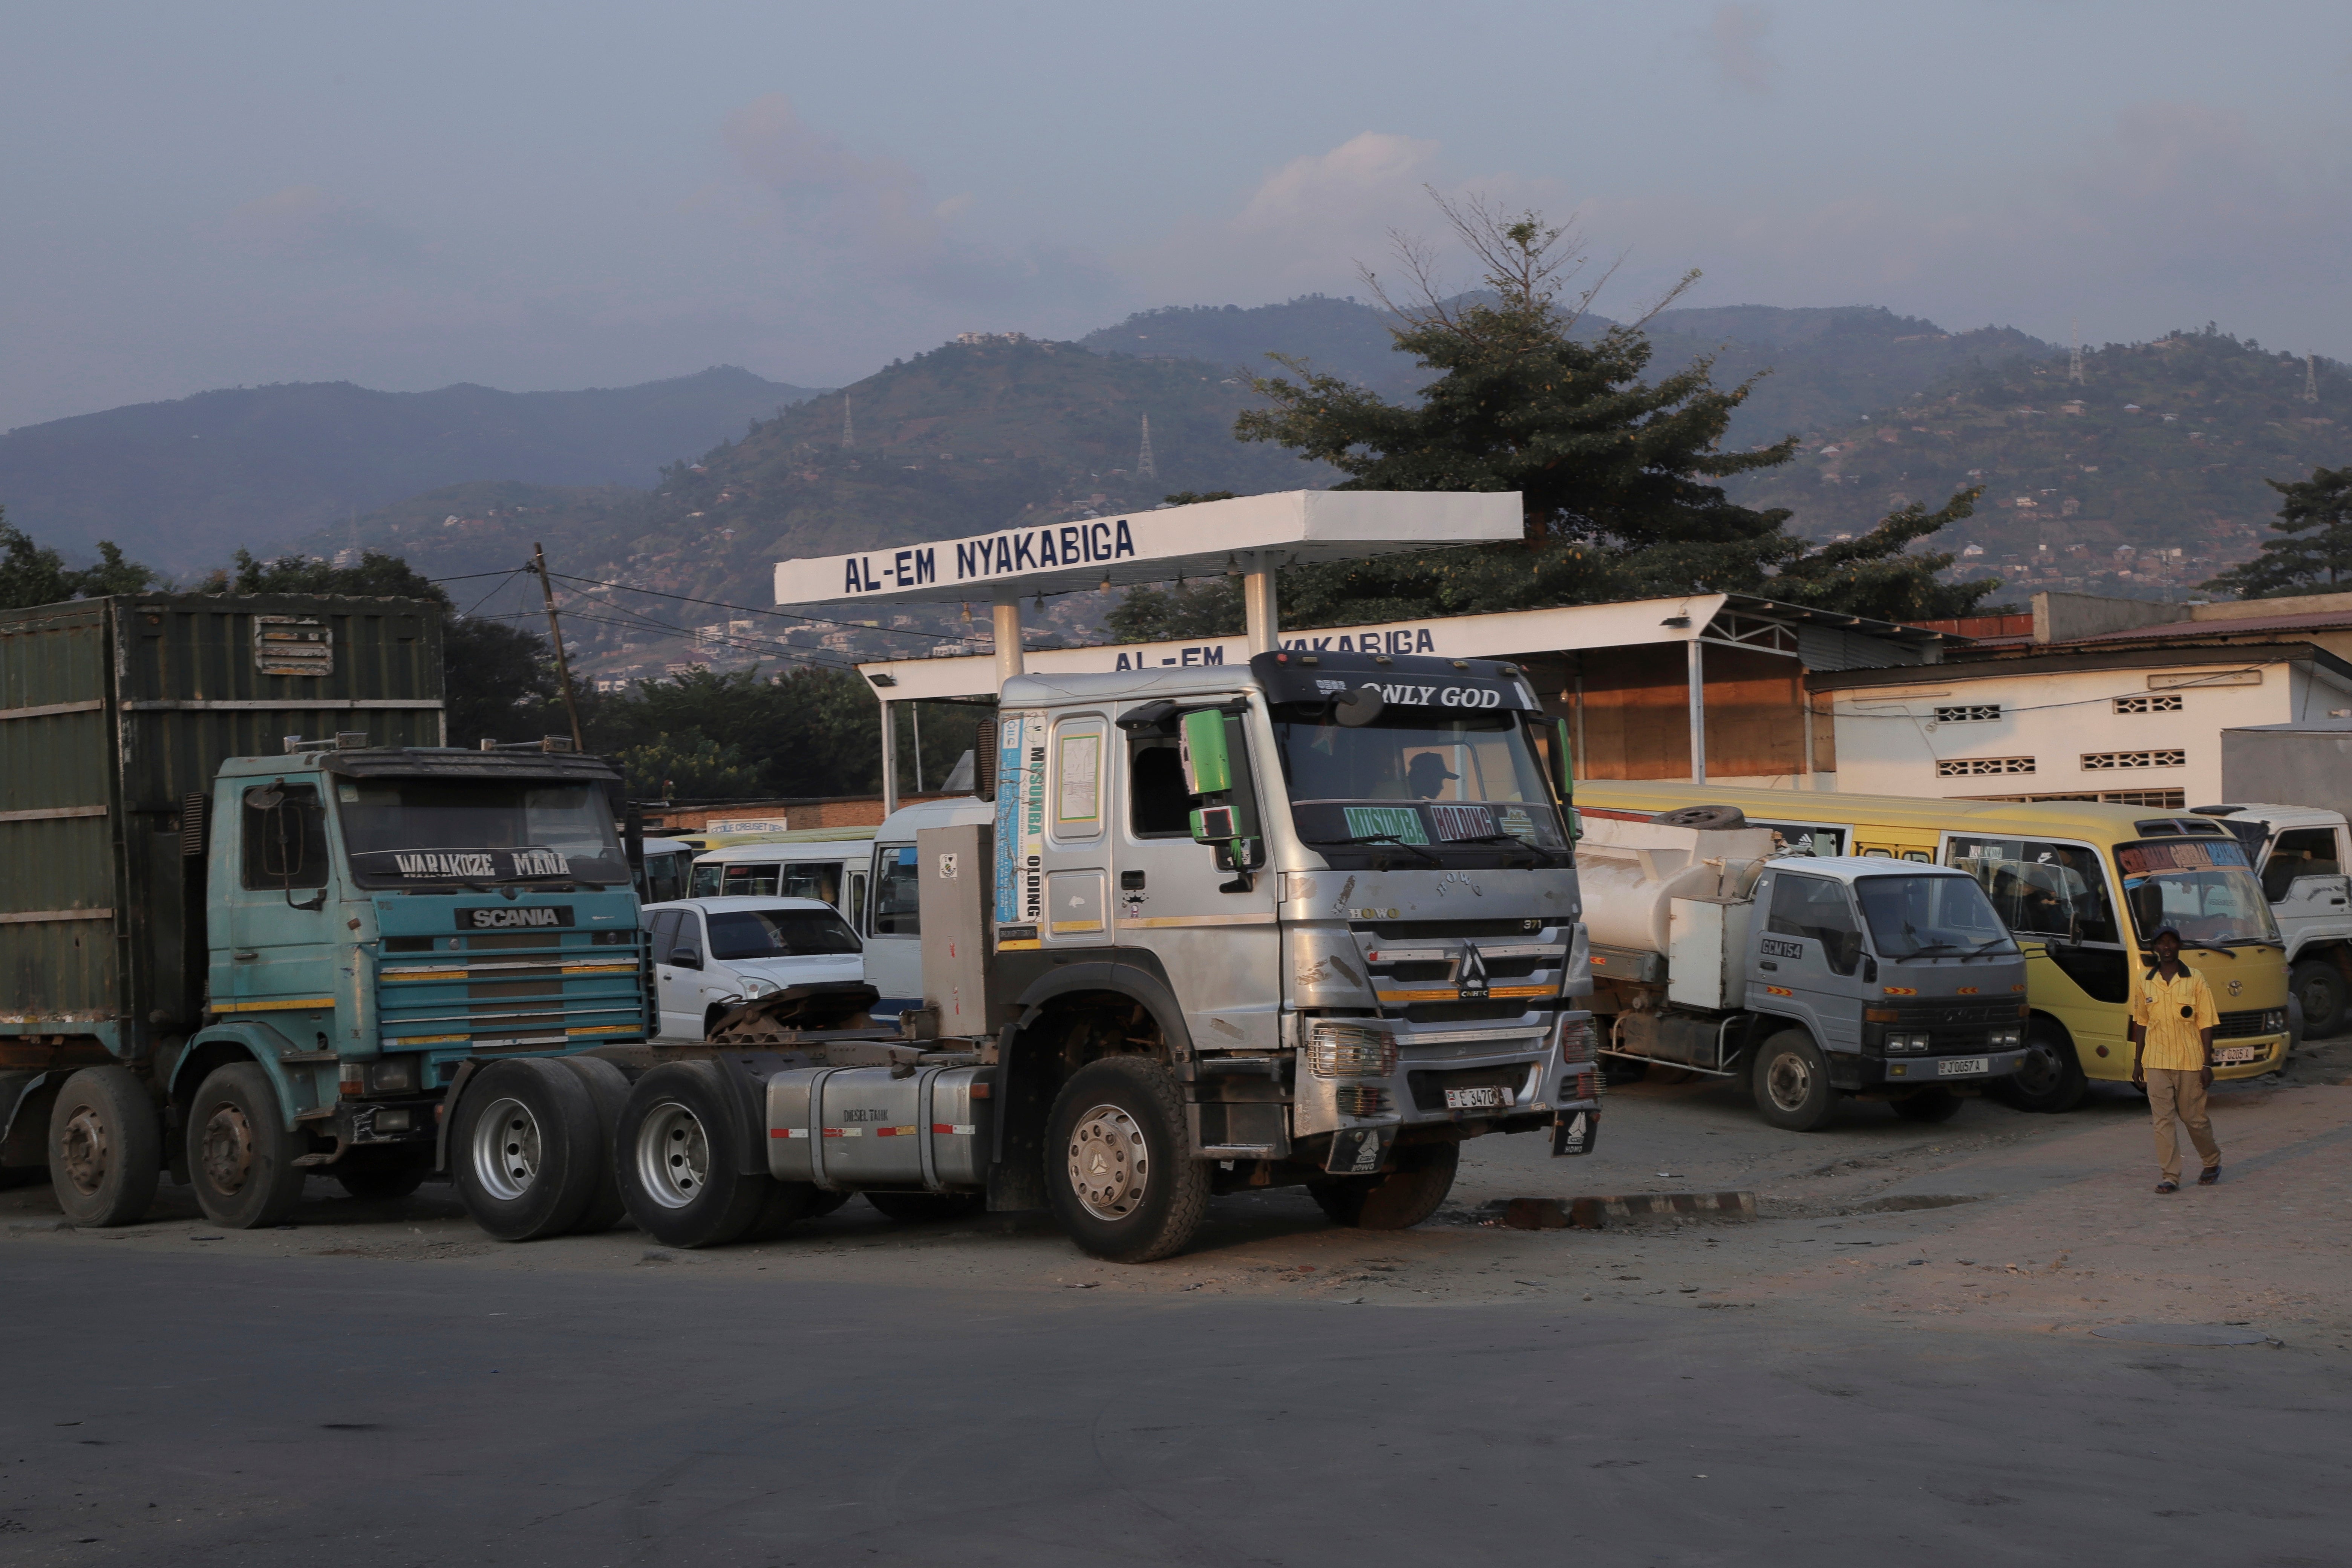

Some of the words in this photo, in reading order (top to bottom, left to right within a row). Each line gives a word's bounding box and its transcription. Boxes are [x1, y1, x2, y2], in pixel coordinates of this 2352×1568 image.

[845, 547, 935, 593] AL-EM
[957, 519, 1135, 579] NYAKABIGA
[1441, 687, 1501, 708] GOD
[1027, 747, 1044, 835] MUSUMBA
[1432, 806, 1496, 841] HOLDING
[394, 853, 496, 878] WARAKOZE
[511, 853, 571, 876] MANA
[1027, 844, 1041, 918] HOLDING
[1436, 871, 1482, 897] HOWO
[473, 908, 559, 927] SCANIA
[1348, 908, 1401, 919] HOWO
[1524, 919, 1541, 929] 371
[844, 1109, 868, 1122] DIESEL
[869, 1109, 888, 1122] TANK
[1351, 1163, 1375, 1172] HOWO
